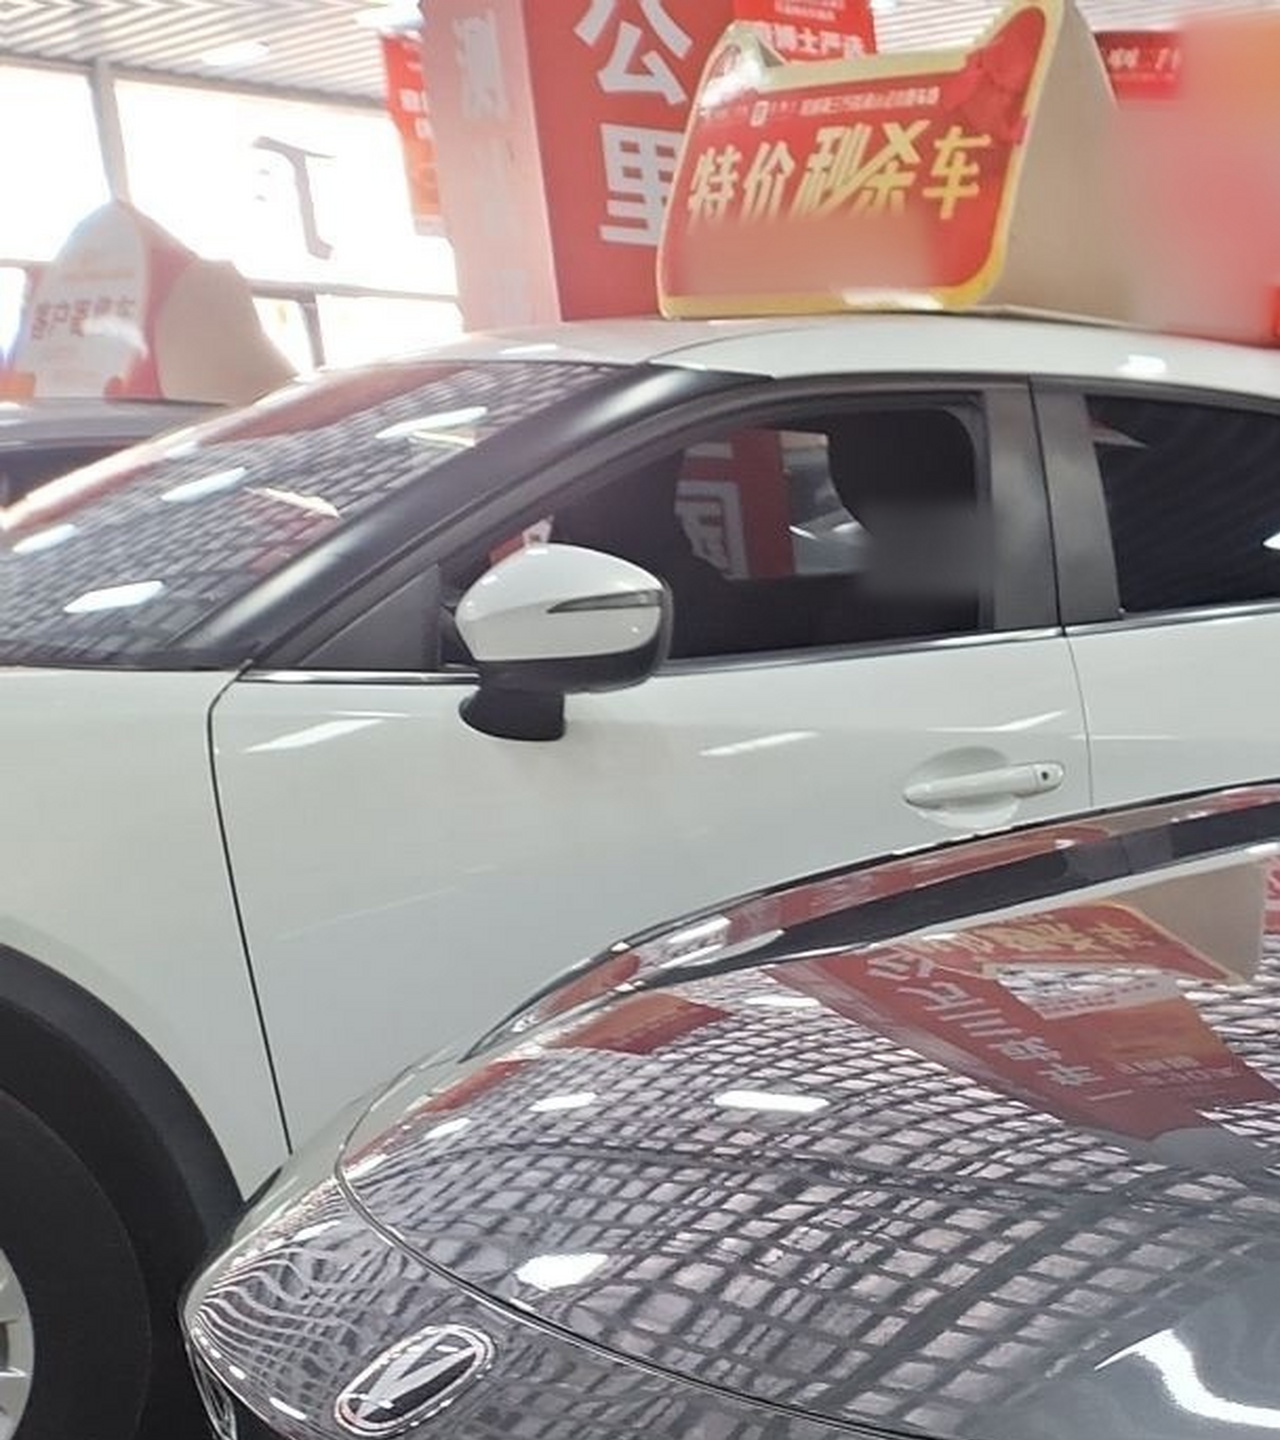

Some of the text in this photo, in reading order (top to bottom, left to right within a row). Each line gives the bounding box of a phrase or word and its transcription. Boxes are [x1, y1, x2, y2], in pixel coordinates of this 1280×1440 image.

[574, 0, 693, 248] 公里
[687, 118, 992, 224] 特价秒杀车
